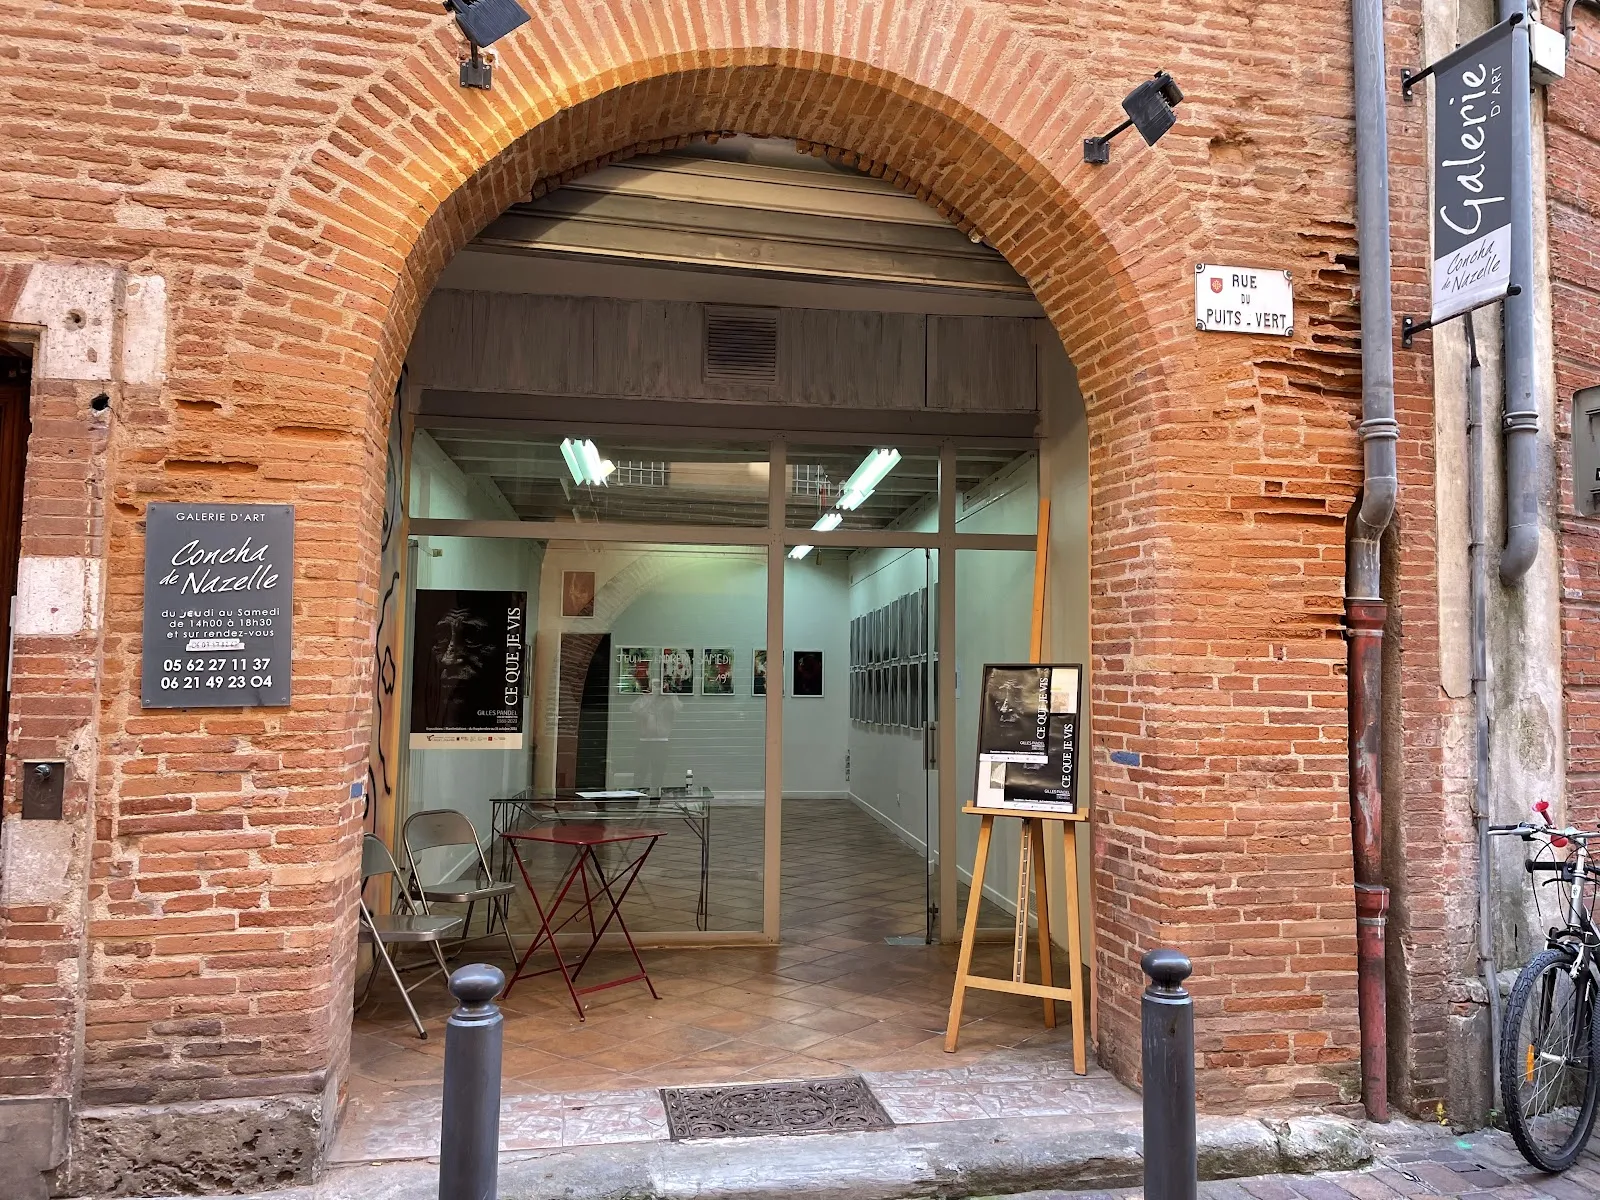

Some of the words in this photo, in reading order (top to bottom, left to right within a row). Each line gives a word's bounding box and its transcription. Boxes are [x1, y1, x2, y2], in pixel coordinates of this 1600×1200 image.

[1490, 65, 1502, 117] D'ART
[1439, 63, 1505, 236] Galerie
[1446, 239, 1495, 275] Concha
[1232, 273, 1257, 289] RUE
[1441, 281, 1451, 290] de
[1451, 253, 1501, 293] Nazelle
[1241, 293, 1251, 304] DU
[176, 512, 226, 522] GALERIE
[230, 513, 266, 522] D'ART
[171, 537, 269, 566] Concha
[159, 568, 180, 585] de
[180, 564, 279, 594] Nazelle
[161, 609, 176, 618] du
[218, 609, 233, 617] au
[237, 607, 280, 617] Samedi
[507, 607, 521, 631] VIS
[169, 619, 184, 628] de
[189, 619, 223, 628] 14h00
[226, 618, 235, 627] à
[239, 618, 273, 627] 18h30
[166, 630, 179, 639] et
[183, 630, 199, 638] sur
[203, 629, 275, 638] rendez-vous
[507, 633, 522, 649] JE
[163, 659, 182, 671] 05
[186, 659, 205, 671] 62
[208, 659, 226, 671] 27
[231, 658, 247, 671] 11
[252, 658, 271, 670] 37
[505, 652, 521, 683] QUE
[160, 677, 179, 689] 06
[183, 677, 200, 689] 21
[205, 676, 224, 689] 49
[227, 676, 246, 688] 23
[1040, 677, 1049, 691] VIS
[504, 686, 518, 706] CE
[1039, 691, 1048, 703] JE
[1037, 703, 1048, 725] QUE
[1037, 725, 1046, 740] CE
[1064, 723, 1074, 739] VIS
[1063, 740, 1073, 751] JE
[1062, 753, 1073, 773] QUE
[1061, 775, 1071, 788] CE
